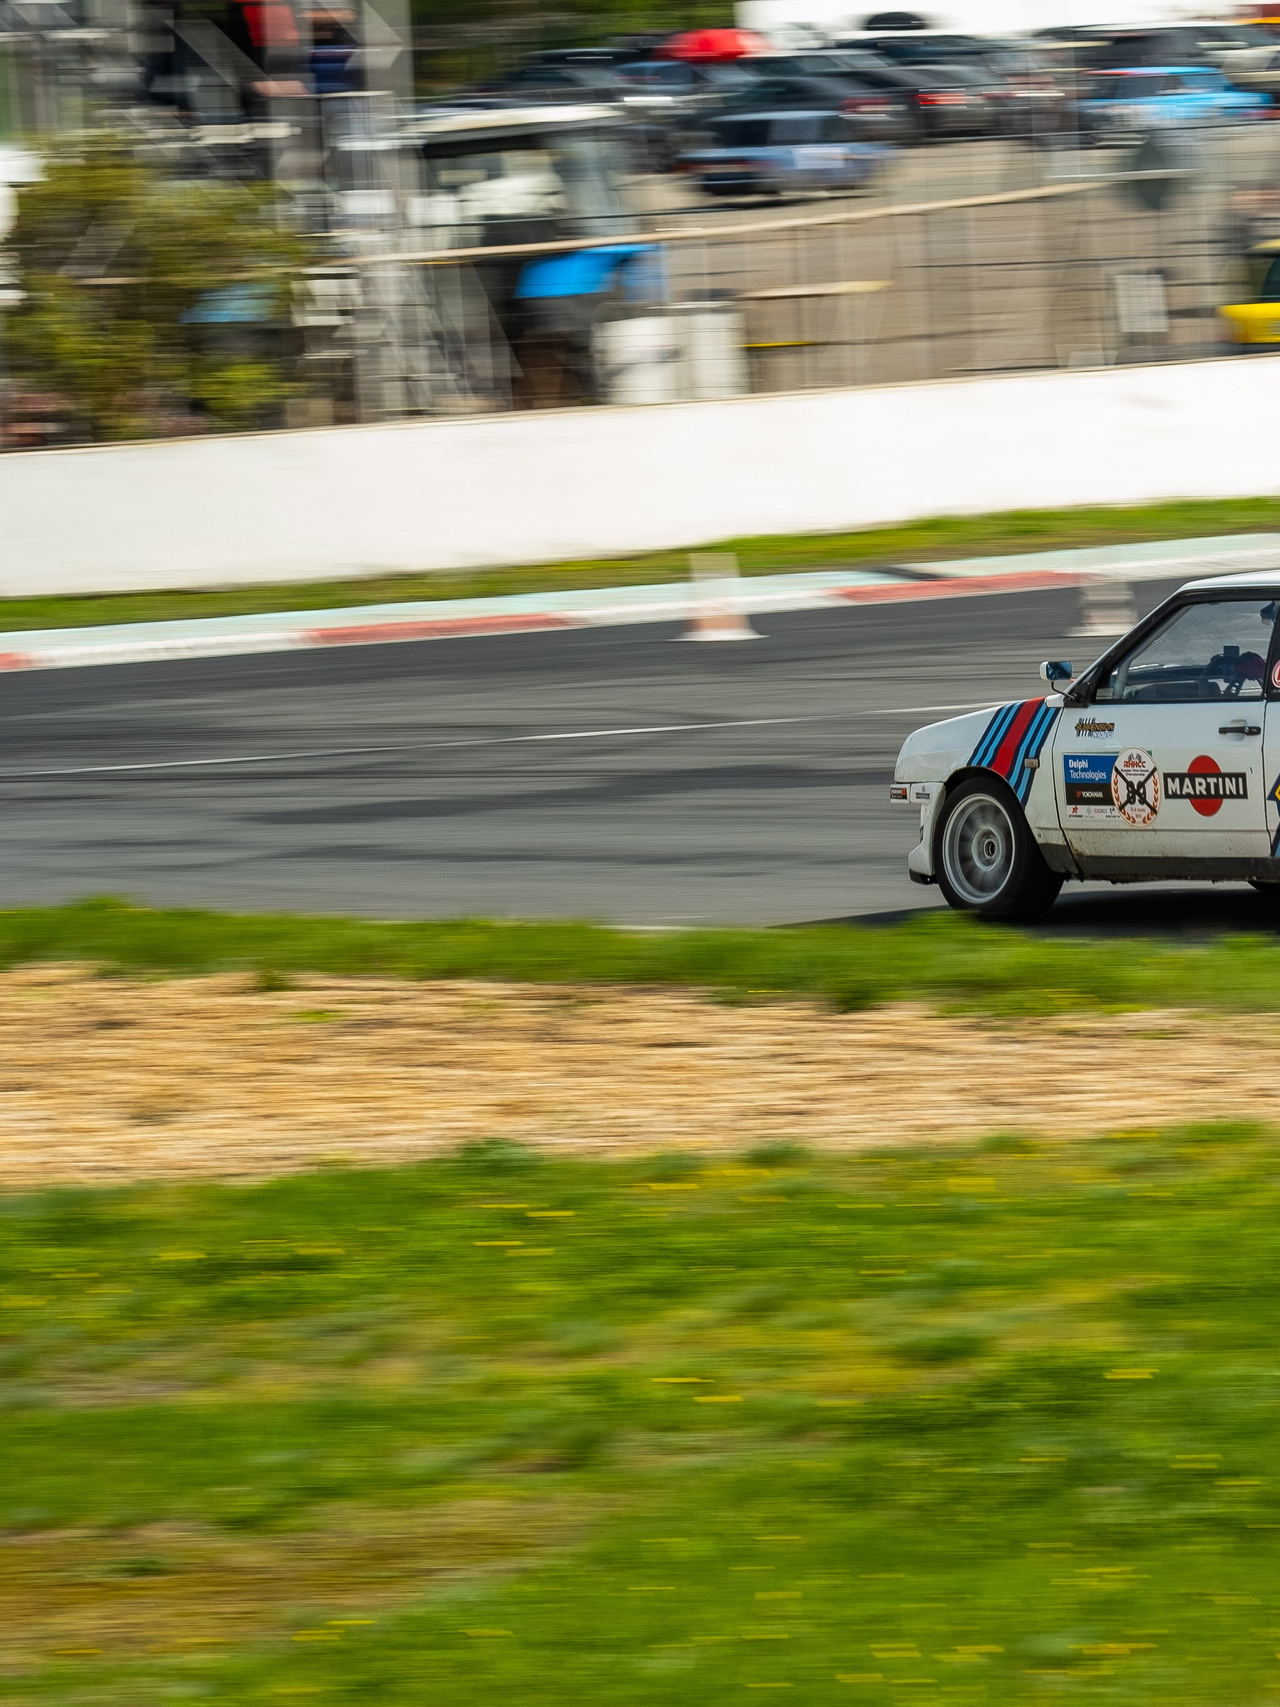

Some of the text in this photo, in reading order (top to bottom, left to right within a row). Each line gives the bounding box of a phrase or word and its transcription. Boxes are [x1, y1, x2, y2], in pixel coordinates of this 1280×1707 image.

[1068, 759, 1089, 769] Delphi
[1069, 770, 1107, 781] Technologies
[1167, 777, 1244, 796] MARTINI
